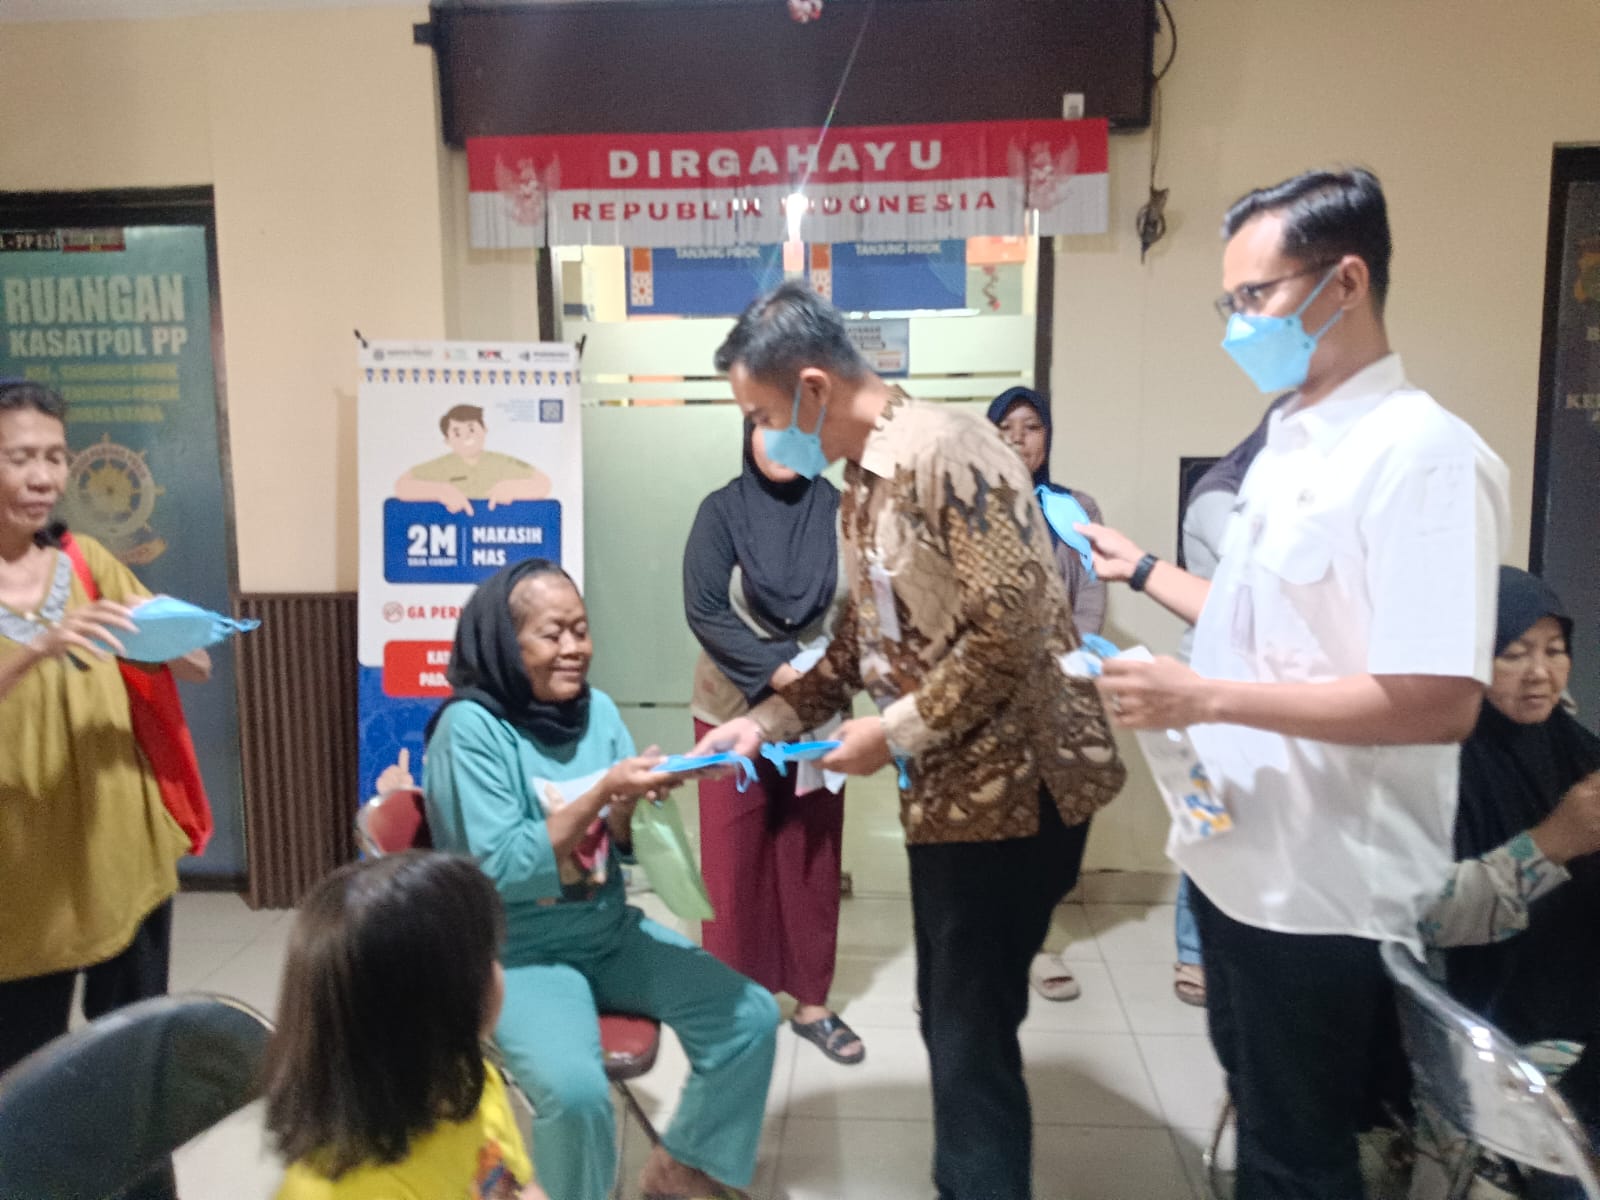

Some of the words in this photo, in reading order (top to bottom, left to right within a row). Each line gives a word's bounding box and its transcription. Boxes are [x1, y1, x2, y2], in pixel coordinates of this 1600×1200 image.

[608, 140, 943, 179] DIRGAHAYU
[572, 200, 763, 221] REPUBLIK
[4, 273, 186, 325] RUANGAN
[8, 328, 147, 357] KASATPOL
[152, 326, 188, 355] PP
[407, 524, 457, 557] 2M
[472, 527, 543, 544] MAKASIH
[472, 549, 506, 566] MAS
[407, 606, 425, 619] GA
